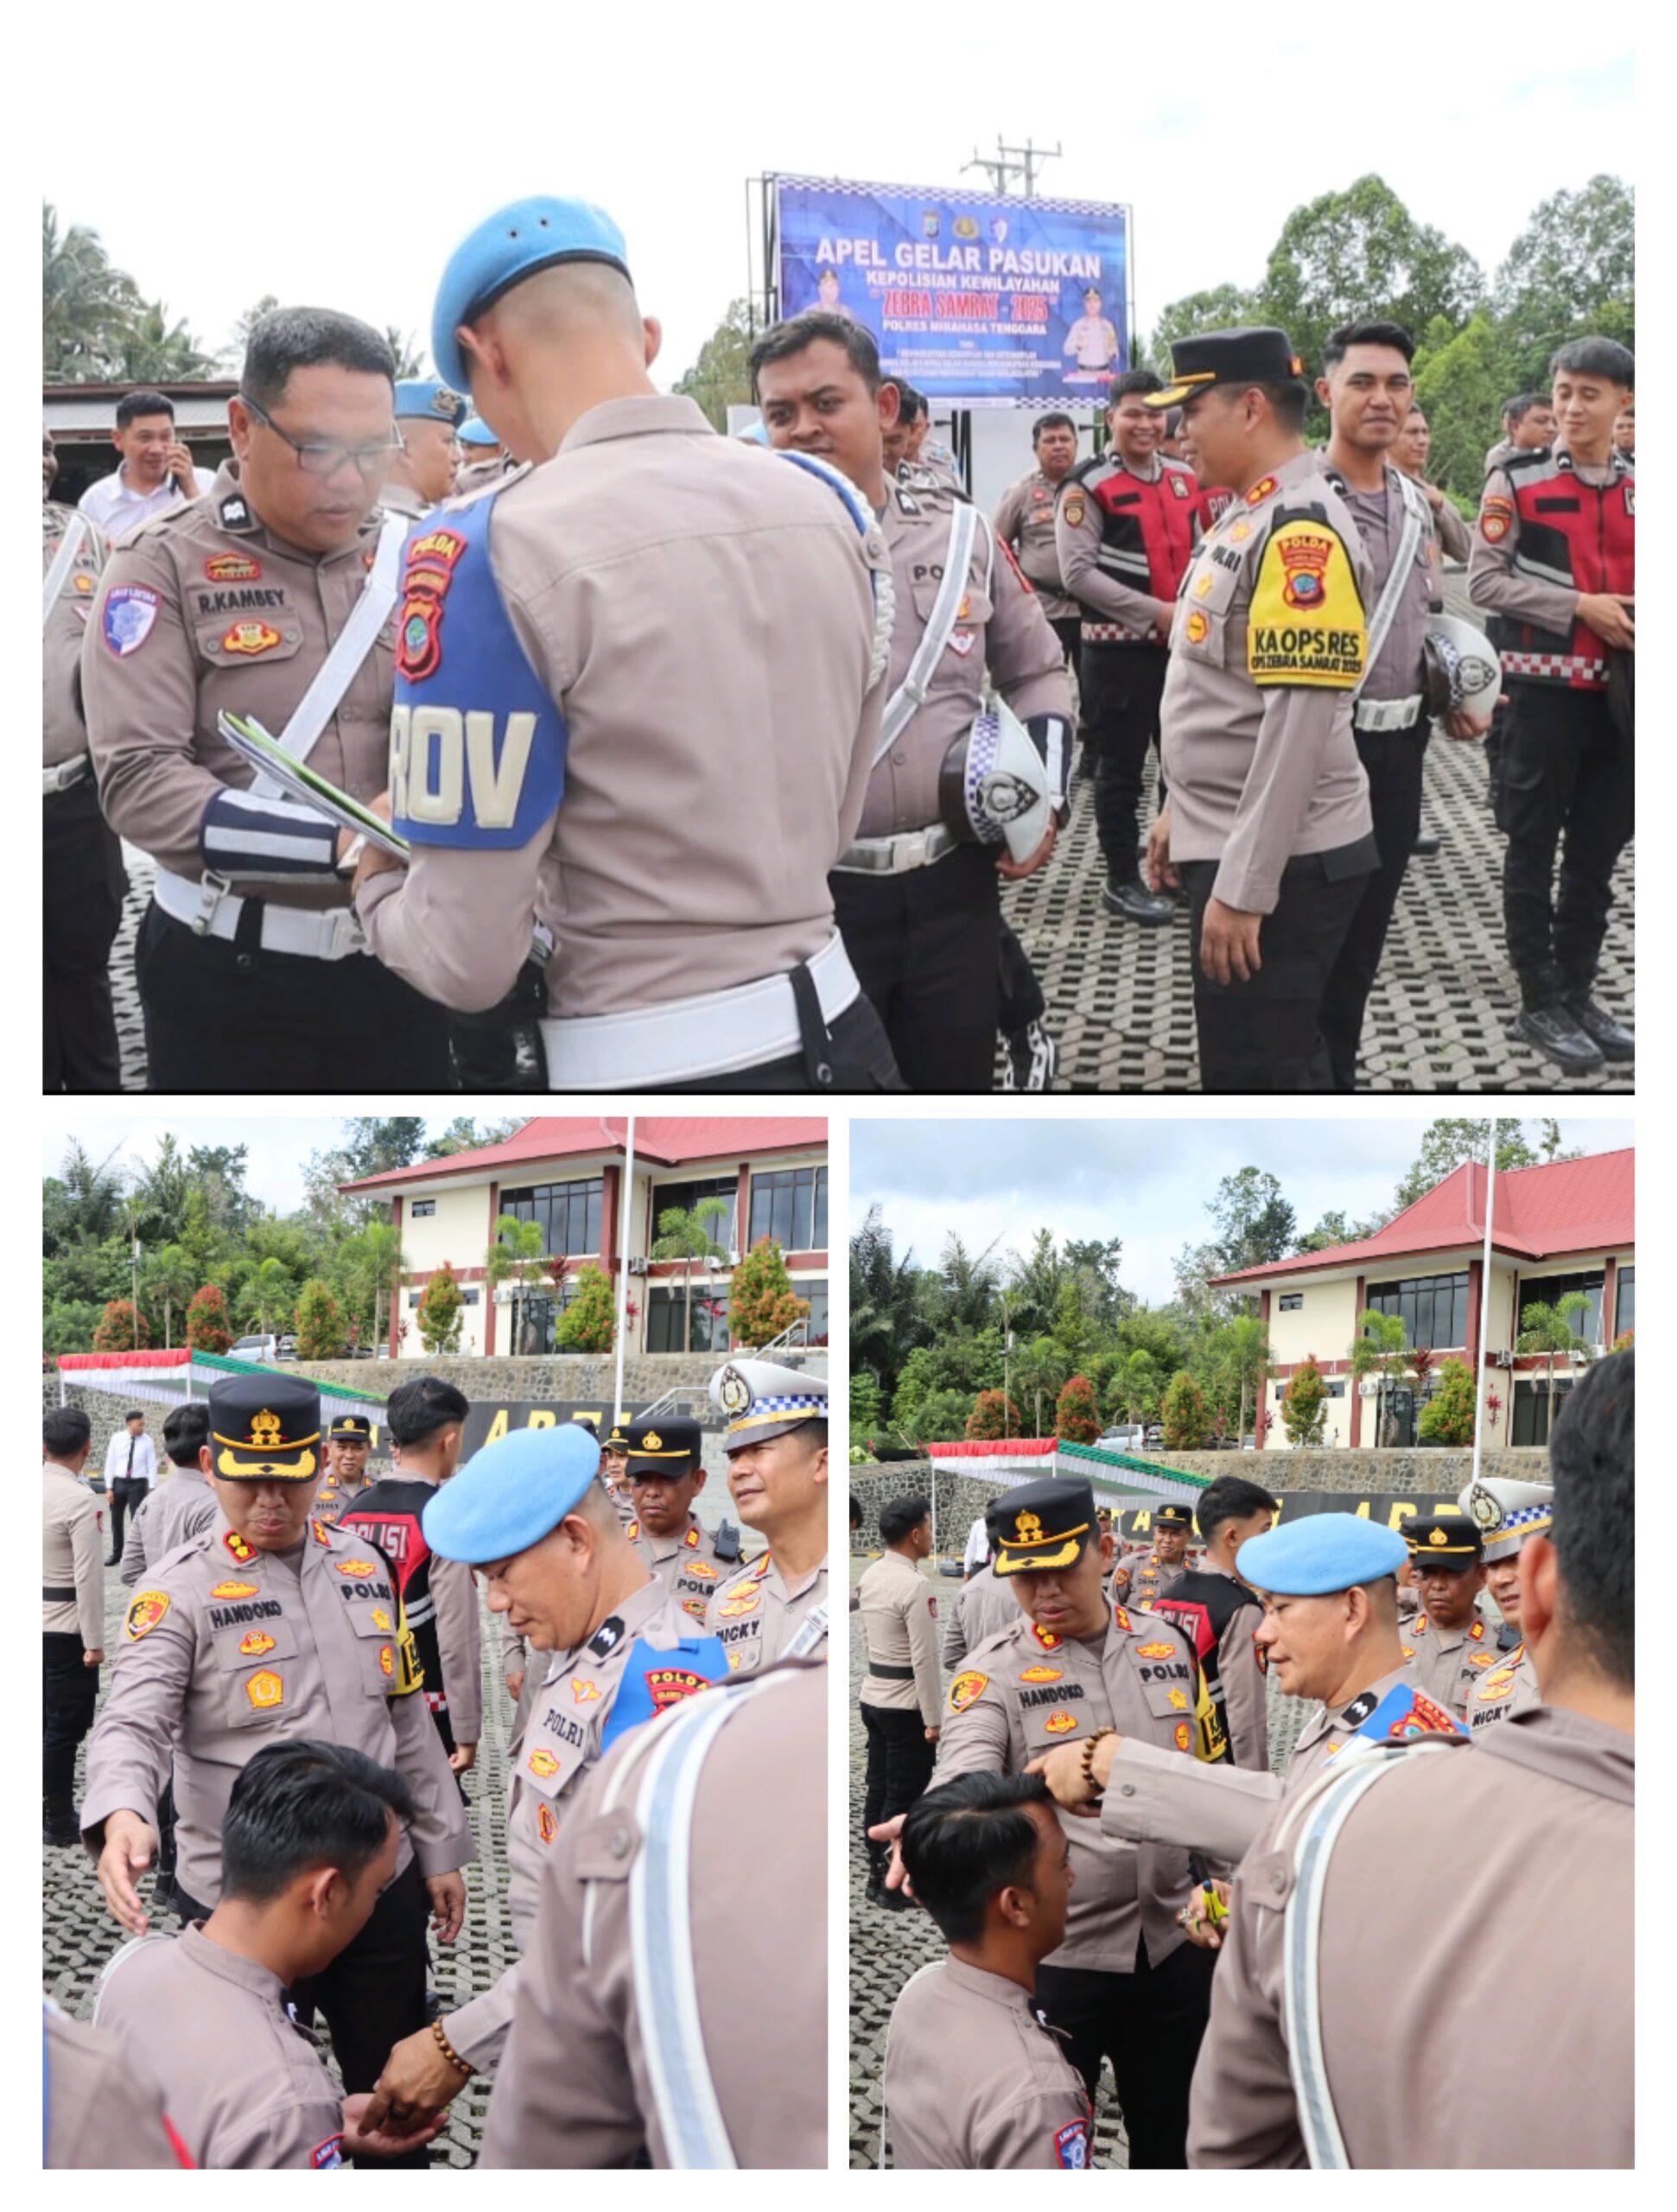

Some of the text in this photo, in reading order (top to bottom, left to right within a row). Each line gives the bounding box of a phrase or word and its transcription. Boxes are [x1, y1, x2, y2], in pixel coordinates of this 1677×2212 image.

[815, 238, 1102, 279] APEL GELAR PASUKAN
[866, 270, 1060, 294] KEPOLISIAN KEWILAYAHAN
[1281, 535, 1328, 552] POLDA
[1255, 628, 1360, 658] KA OPS RES
[210, 1600, 283, 1629] HANDOKO
[651, 1671, 708, 1691] POLDA
[1020, 1683, 1085, 1708] HANDOKO
[543, 1708, 585, 1749] POLRI
